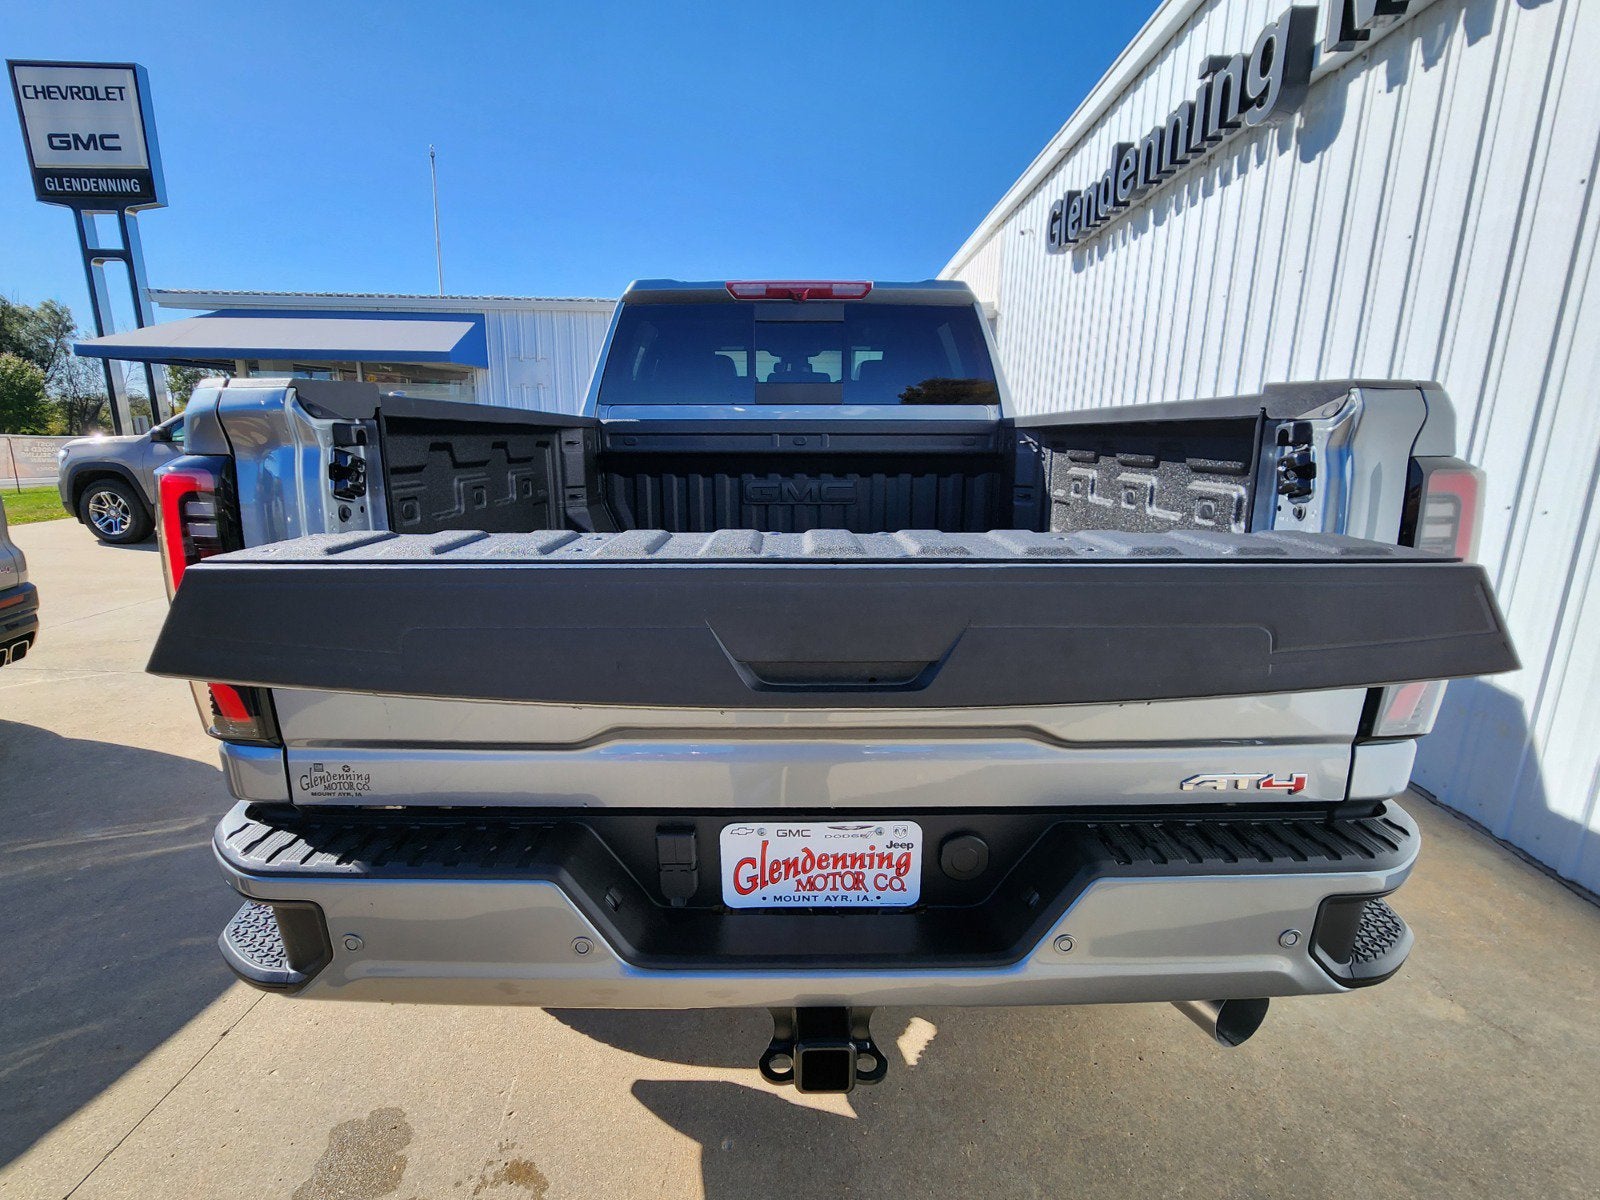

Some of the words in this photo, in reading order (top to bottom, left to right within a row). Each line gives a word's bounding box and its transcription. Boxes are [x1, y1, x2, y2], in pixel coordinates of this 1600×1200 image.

[22, 84, 126, 102] CHEVROLET
[1045, 4, 1302, 255] Glendenning
[47, 132, 122, 151] GMC
[44, 176, 141, 193] GLENDENNING
[745, 481, 855, 502] GMC
[300, 767, 370, 791] Glendenning
[324, 781, 356, 792] MOTOR
[1180, 773, 1308, 796] AT4
[776, 829, 812, 838] GMC
[886, 840, 914, 851] Jeep
[733, 840, 912, 896] Glendenning
[794, 870, 870, 893] MOTOR
[773, 894, 819, 903] MOUNT
[824, 894, 852, 903] AYR,
